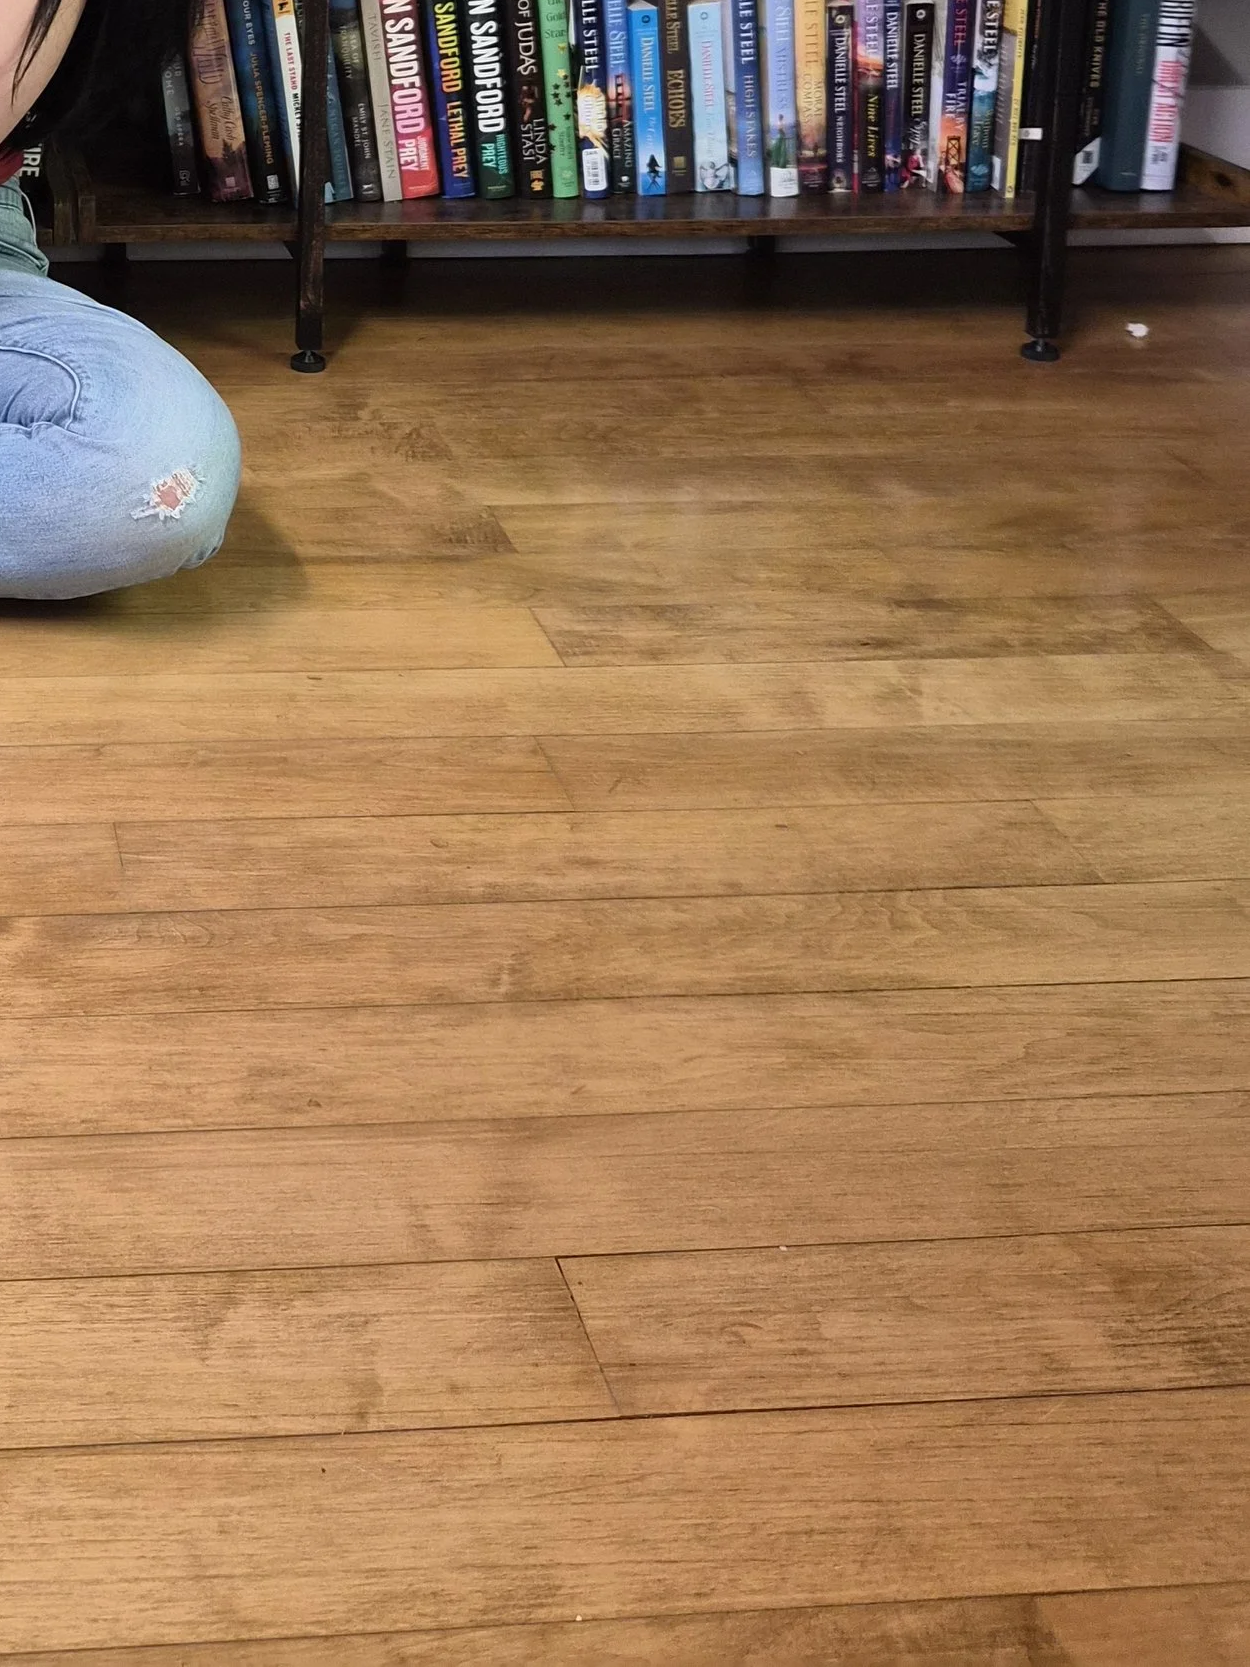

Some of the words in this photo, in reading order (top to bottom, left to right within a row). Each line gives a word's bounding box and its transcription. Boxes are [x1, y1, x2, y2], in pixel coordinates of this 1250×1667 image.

[518, 0, 530, 17] OF
[515, 22, 536, 76] JUDAS
[582, 29, 598, 74] STEEL
[739, 23, 754, 65] STEEL
[384, 18, 426, 134] SANDFORD
[470, 22, 504, 134] SANDFORD
[668, 69, 686, 128] ECHOES
[521, 124, 536, 162] STASI
[532, 118, 547, 164] LINDA
